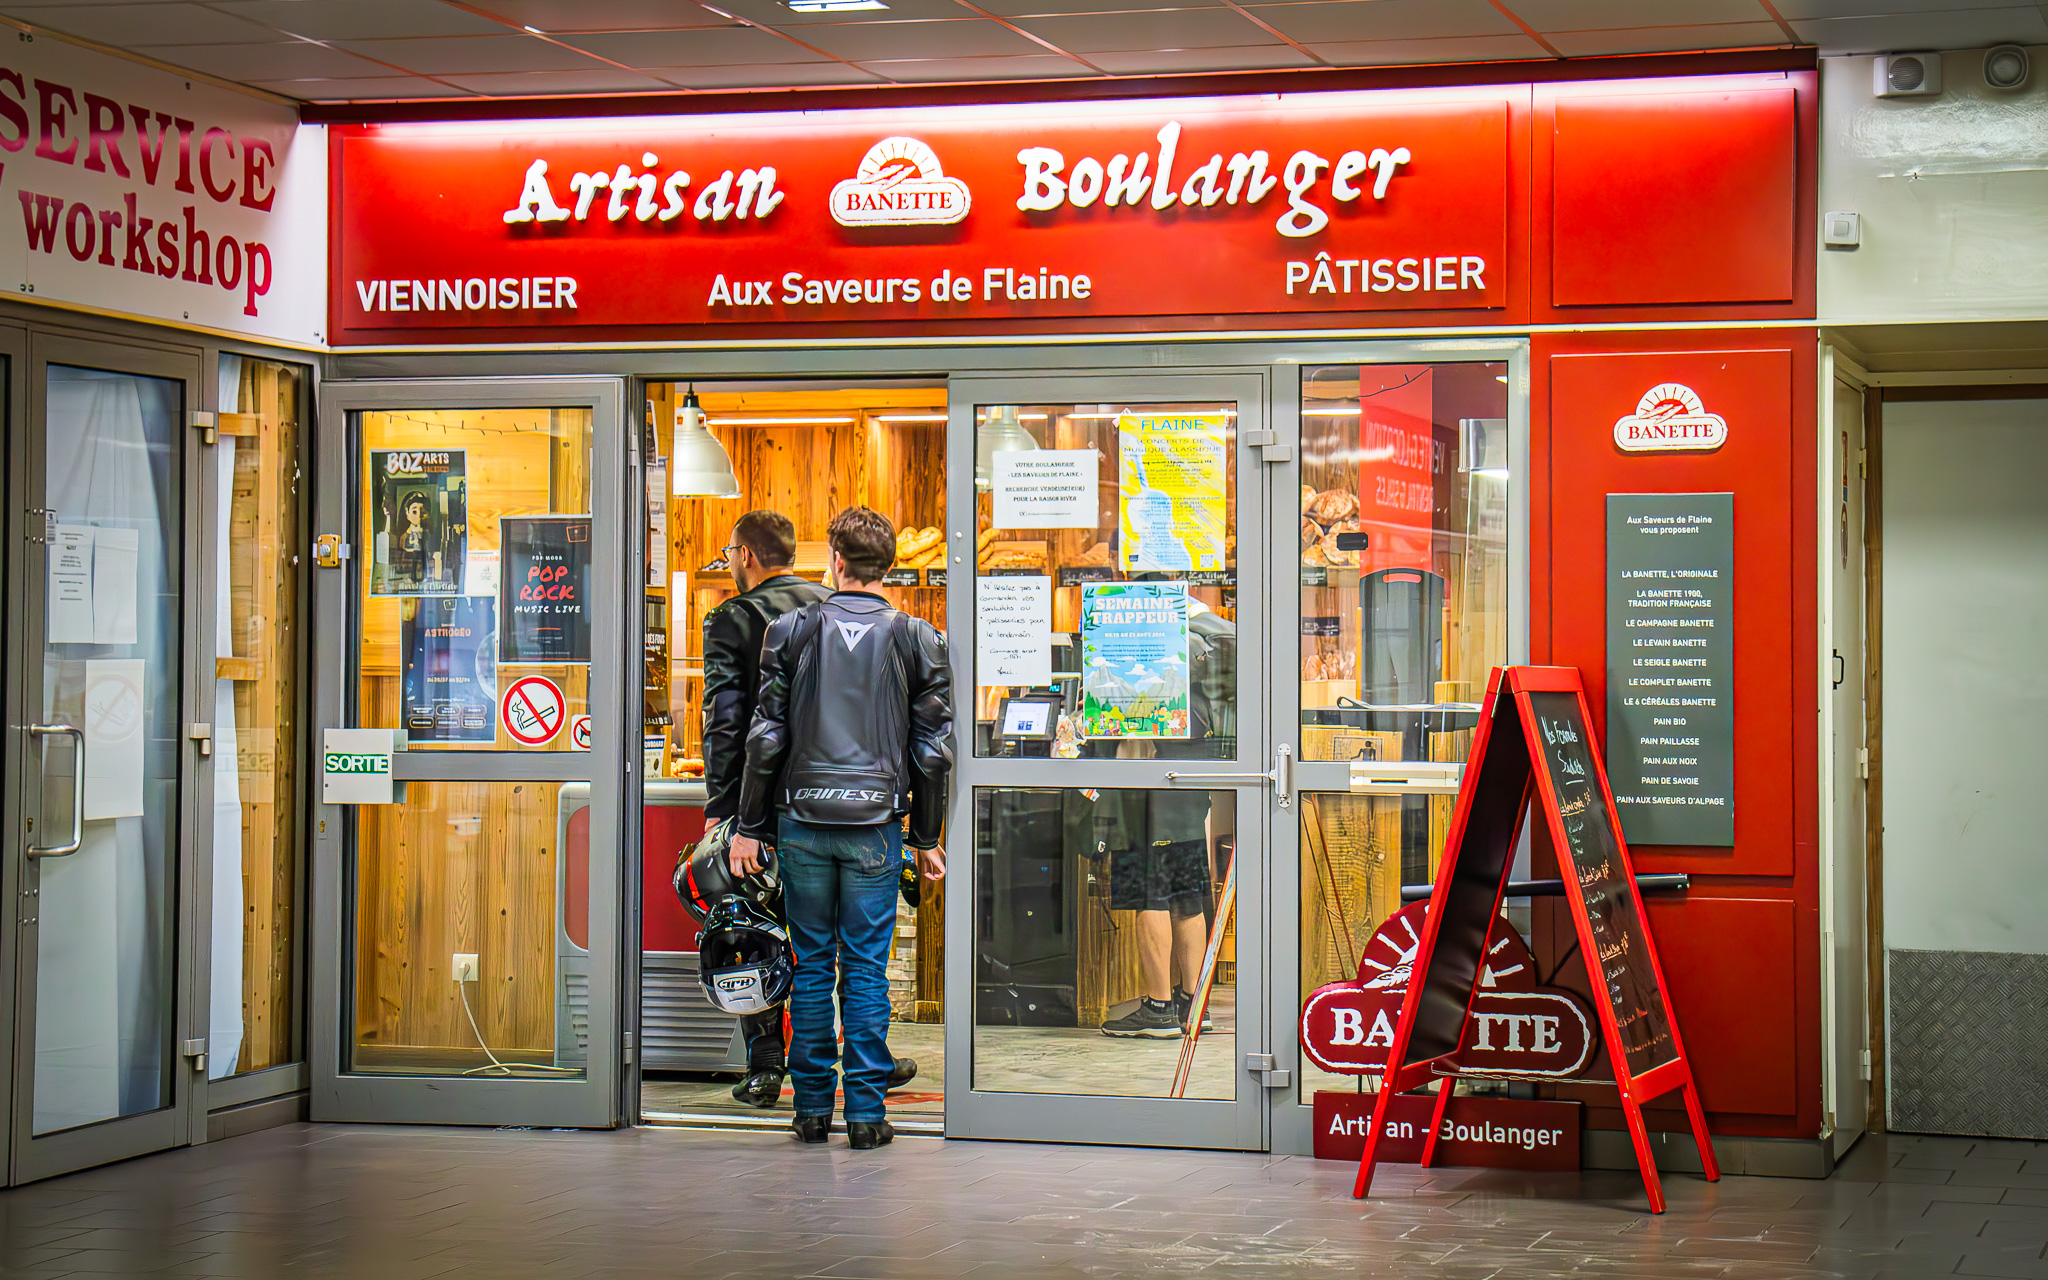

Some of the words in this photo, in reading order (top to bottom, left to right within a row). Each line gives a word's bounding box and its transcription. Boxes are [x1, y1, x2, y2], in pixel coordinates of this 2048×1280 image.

[0, 67, 275, 213] SERVICE
[503, 152, 785, 224] Artisan
[1016, 120, 1412, 237] Boulanger
[846, 191, 953, 211] BANETTE
[18, 189, 272, 317] workshop
[1285, 251, 1486, 295] PÂTISSIER
[708, 274, 772, 306] Aux
[781, 273, 921, 305] Saveurs
[931, 268, 972, 302] de
[983, 267, 1092, 300] Flaine
[356, 276, 578, 312] VIENNOISIER
[1141, 419, 1205, 431] FLAINE
[1628, 424, 1714, 440] BANETTE
[1676, 516, 1686, 524] de
[1688, 516, 1712, 524] Flaine
[1660, 526, 1700, 535] proposent
[528, 566, 568, 582] POP
[1621, 570, 1632, 578] LA
[1633, 570, 1670, 578] BANETTE,
[1671, 570, 1718, 578] L'ORIGINALE
[520, 584, 575, 600] ROCK
[1648, 590, 1682, 598] BANETTE
[1684, 590, 1703, 598] 1900,
[514, 605, 550, 614] MUSIC
[554, 604, 581, 614] LIVE
[1095, 597, 1174, 610] SEMAINE
[1628, 600, 1668, 608] TRADITION
[1669, 600, 1712, 608] FRANÇAISE
[1090, 611, 1179, 624] TRAPPEUR
[1625, 619, 1636, 627] LE
[1636, 619, 1678, 627] CAMPAGNE
[1680, 619, 1715, 627] BANETTE
[1632, 639, 1642, 647] LE
[1644, 639, 1671, 647] LEVAIN
[1672, 639, 1707, 647] BANETTE
[1633, 659, 1642, 667] LE
[1644, 659, 1671, 667] SEIGLE
[1672, 659, 1707, 667] BANETTE
[1628, 678, 1639, 686] LE
[1640, 678, 1676, 686] COMPLET
[1677, 678, 1712, 686] BANETTE
[1624, 698, 1634, 706] LE
[1635, 698, 1640, 706] 6
[1641, 697, 1680, 706] CÉRÉALES
[1682, 698, 1716, 706] BANETTE
[1660, 738, 1700, 746] PAILLASSE
[326, 755, 388, 773] SORTIE
[1660, 777, 1672, 785] DE
[1672, 777, 1700, 785] SAVOIE
[794, 788, 888, 803] DAINESE
[1636, 796, 1651, 804] AUX
[1652, 796, 1686, 804] SAVEURS
[1688, 797, 1725, 806] D'ALPAGE
[1329, 1007, 1562, 1053] BATTE
[1329, 1113, 1414, 1138] Artian
